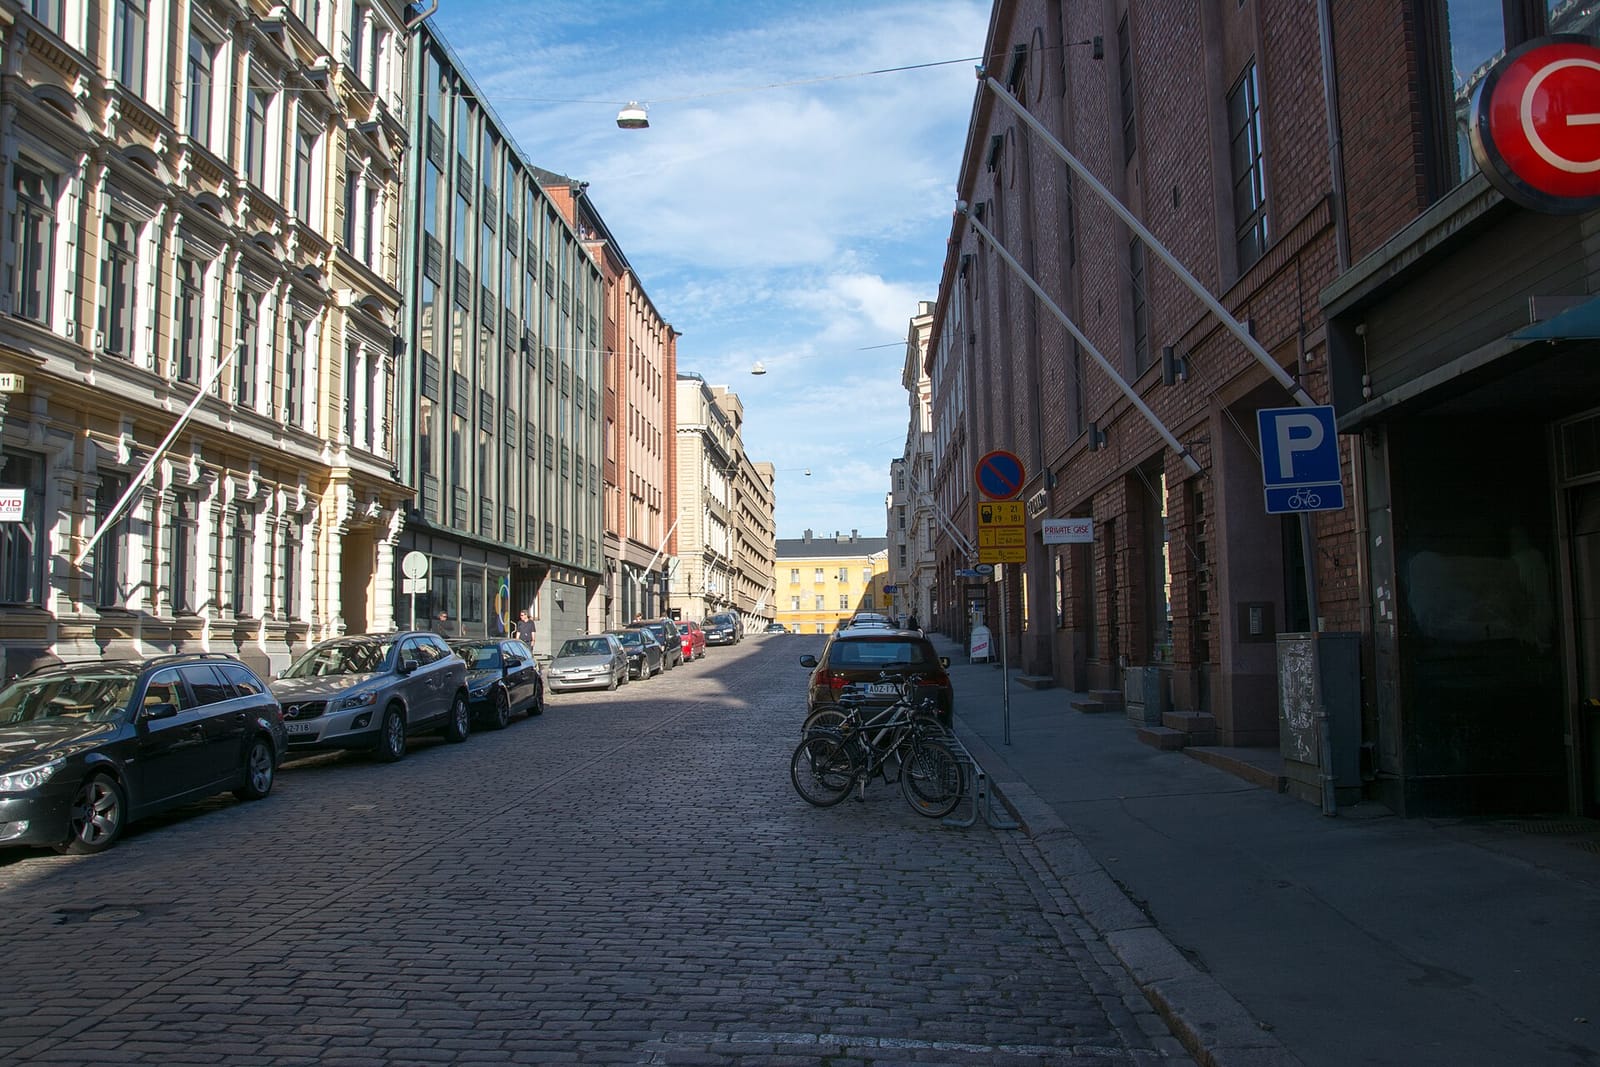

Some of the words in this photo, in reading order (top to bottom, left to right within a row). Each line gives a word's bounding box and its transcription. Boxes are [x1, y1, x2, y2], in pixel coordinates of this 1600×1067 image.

[1520, 58, 1600, 173] G
[1, 377, 10, 386] 11
[1274, 414, 1325, 478] P
[1045, 526, 1071, 534] PRIVATE
